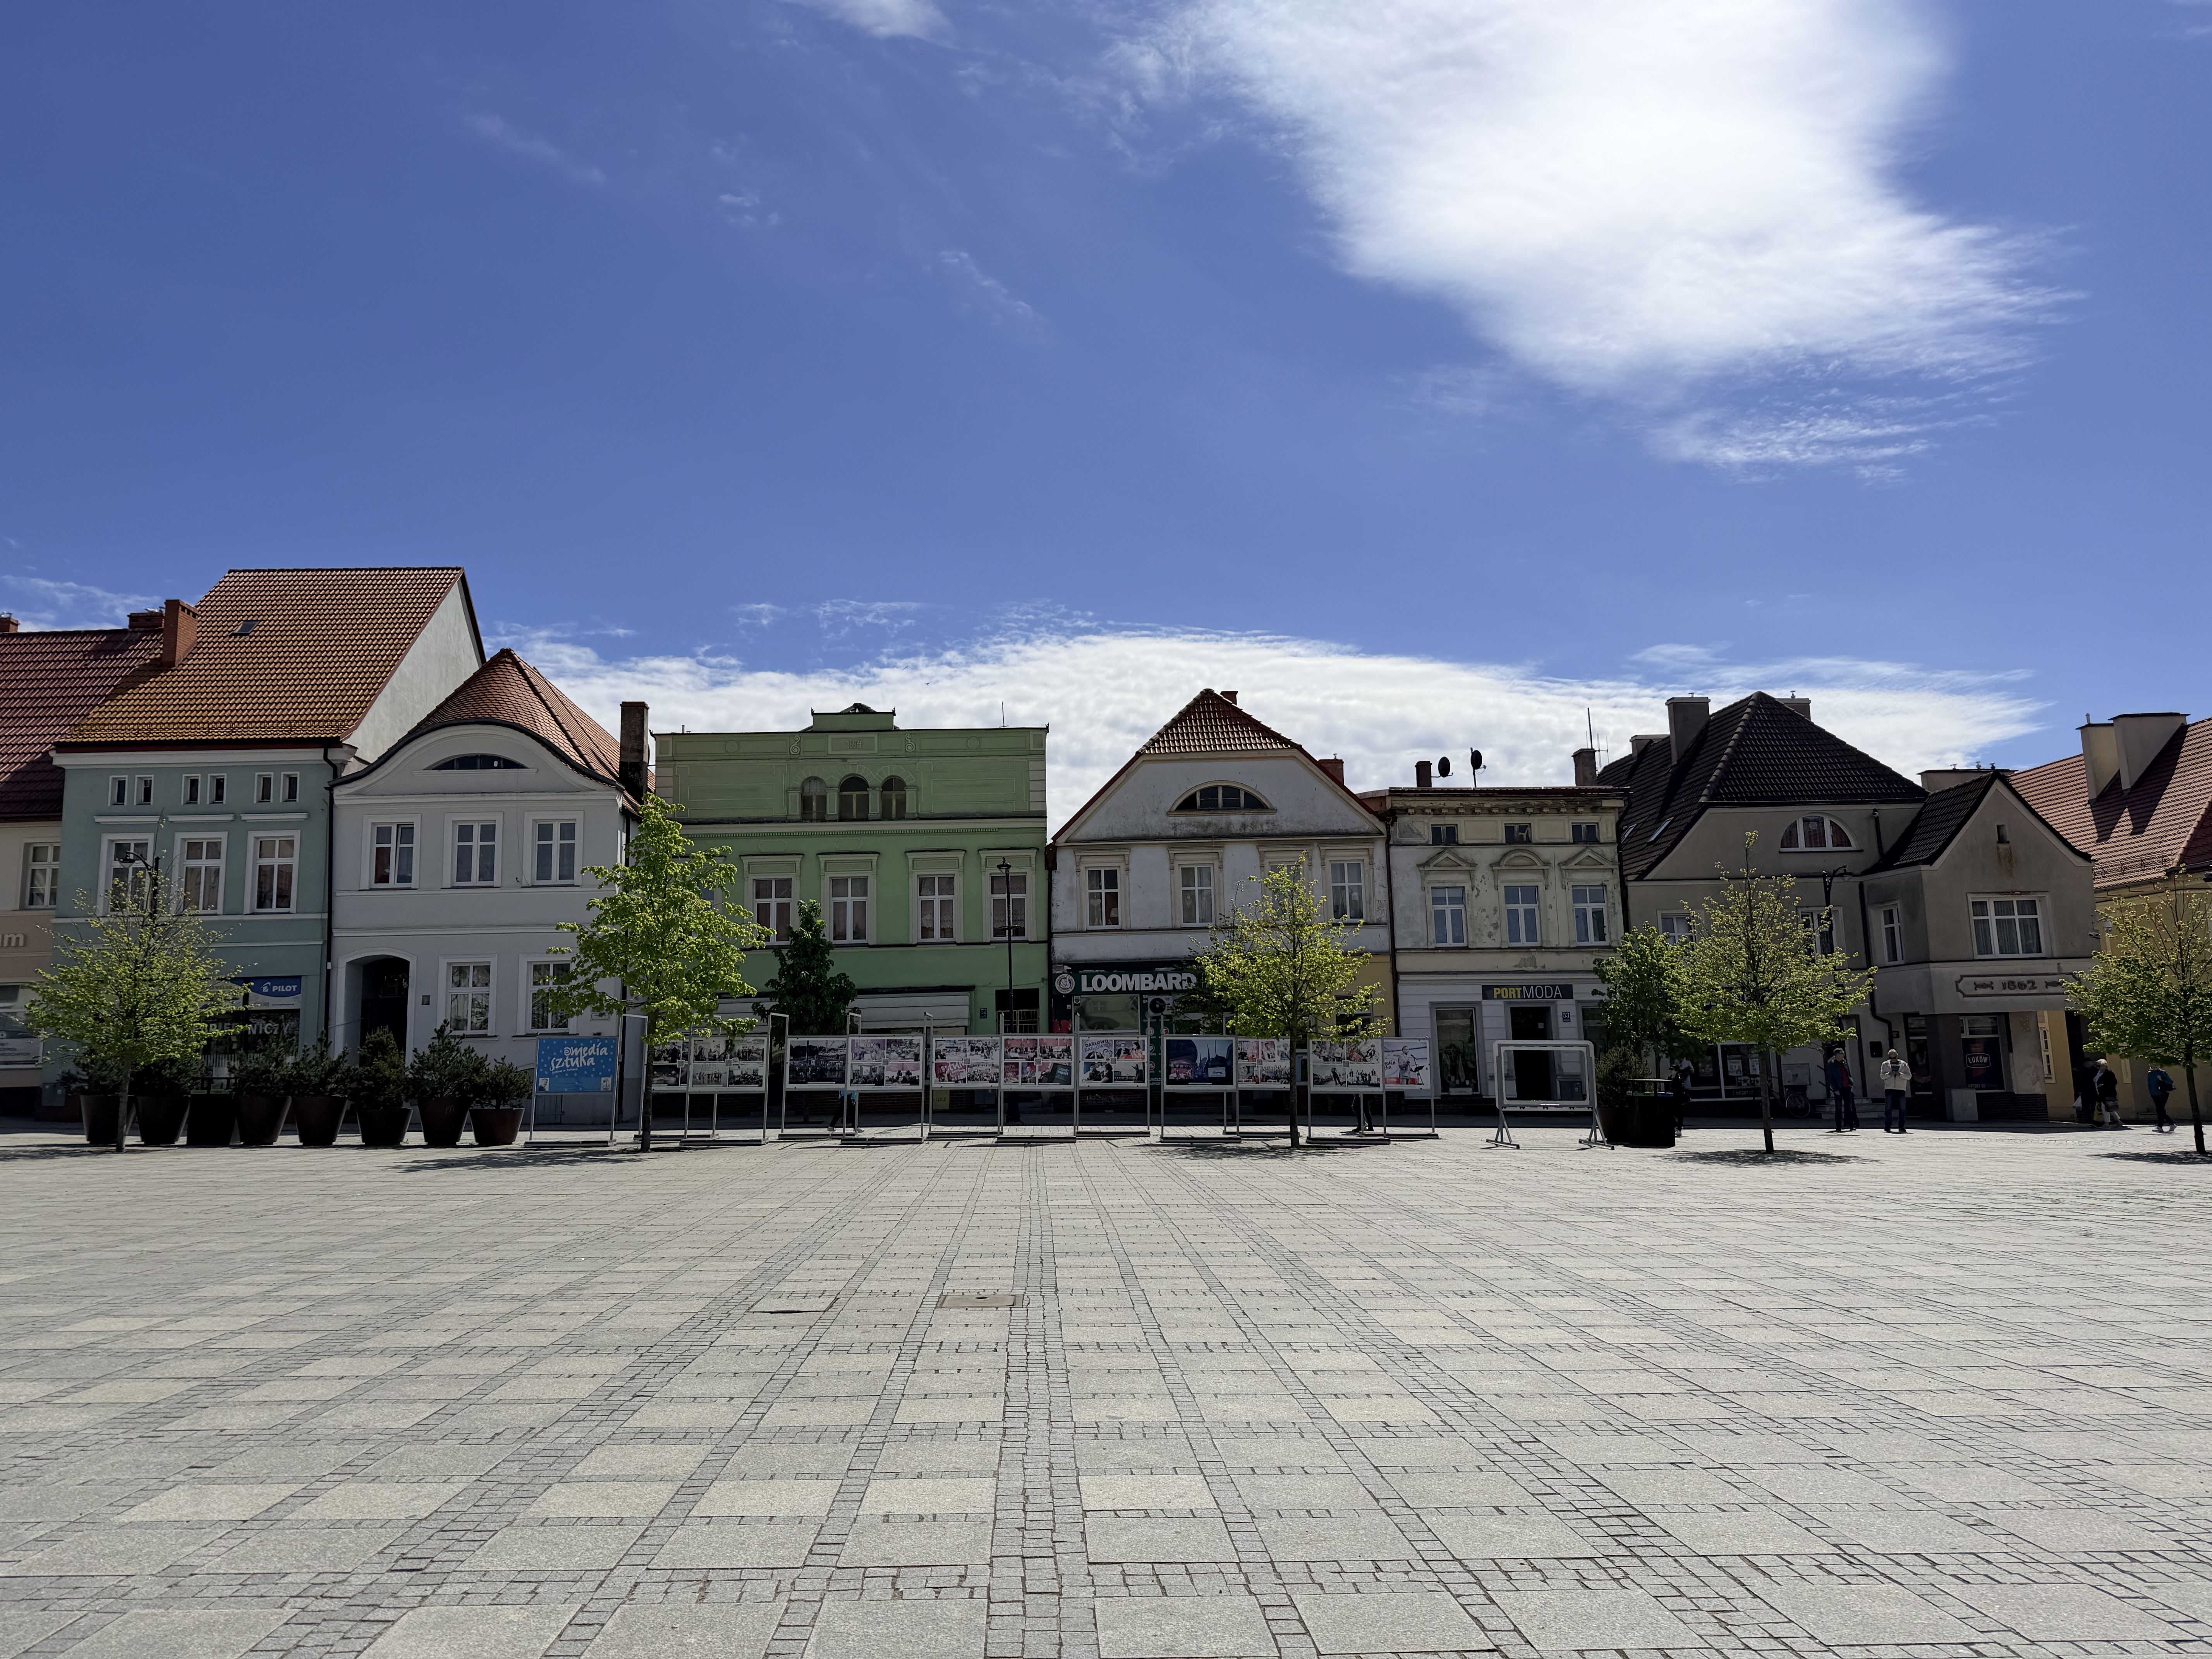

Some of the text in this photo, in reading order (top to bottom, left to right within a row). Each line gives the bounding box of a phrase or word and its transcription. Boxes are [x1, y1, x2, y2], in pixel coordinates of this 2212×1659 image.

[847, 740, 862, 749] 1884
[1081, 973, 1197, 991] LOOMBARD
[1968, 1055, 1988, 1064] ŁUKÓW
